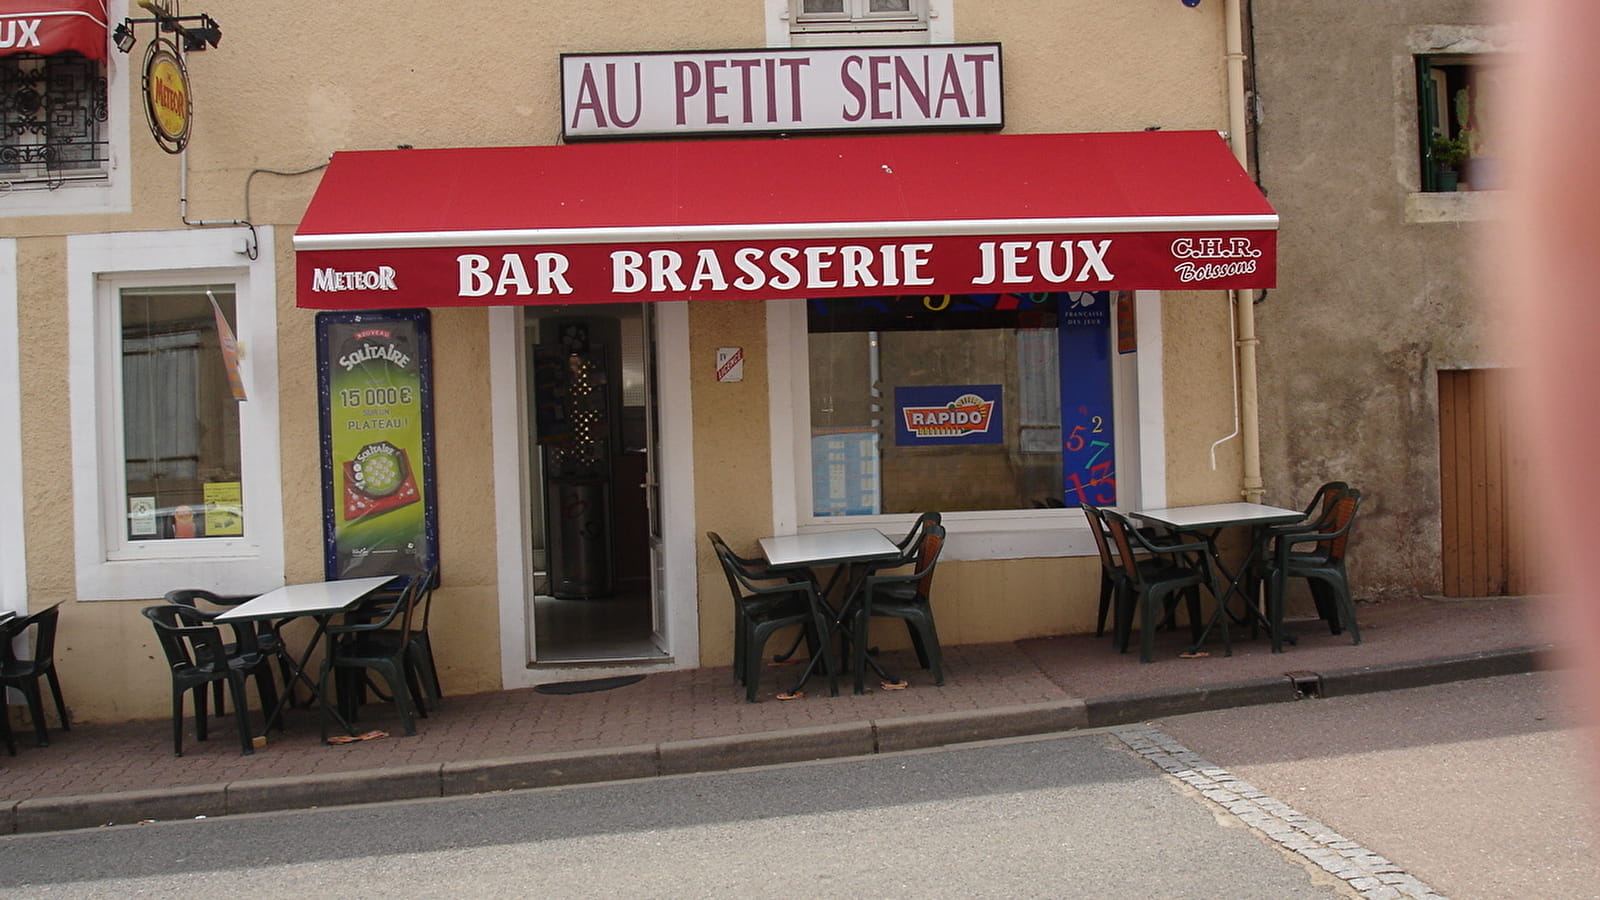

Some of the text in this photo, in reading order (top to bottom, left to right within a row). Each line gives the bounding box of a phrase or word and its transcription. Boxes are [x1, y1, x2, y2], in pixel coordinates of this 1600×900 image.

[572, 53, 995, 129] AU PETIT SENAT
[1171, 238, 1262, 258] C.H.R.
[456, 239, 1115, 297] BAR BRASSERIE JEUX
[1174, 260, 1256, 282] Boissons
[341, 388, 361, 407] 15
[348, 420, 402, 430] PLATEAU
[911, 411, 982, 426] RAPIDO
[1091, 415, 1104, 433] 2
[1065, 425, 1088, 452] 5
[1084, 440, 1111, 470] 7
